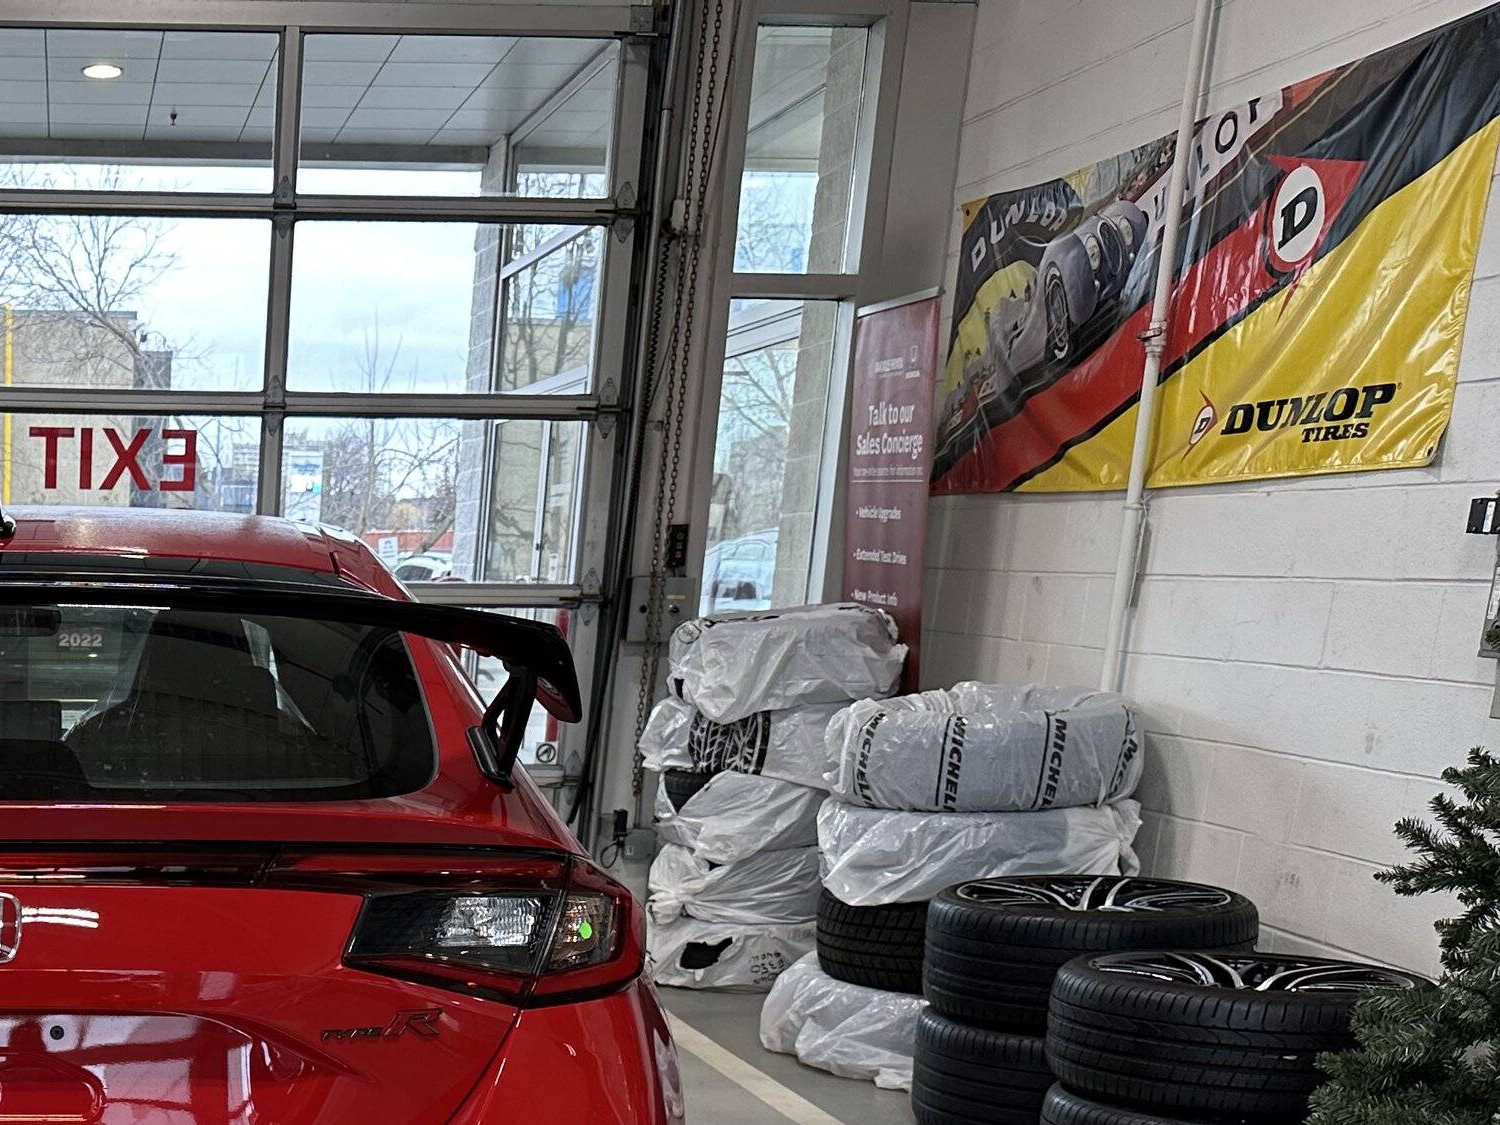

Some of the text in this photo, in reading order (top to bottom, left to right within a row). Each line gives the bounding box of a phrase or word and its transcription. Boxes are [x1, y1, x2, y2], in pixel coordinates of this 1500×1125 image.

[869, 401, 915, 426] Talk to our
[1220, 382, 1397, 436] DUNLOP
[856, 428, 923, 460] Sales Concierge
[1302, 422, 1370, 443] TIRES
[59, 633, 102, 647] 2022
[384, 1008, 442, 1037] R
